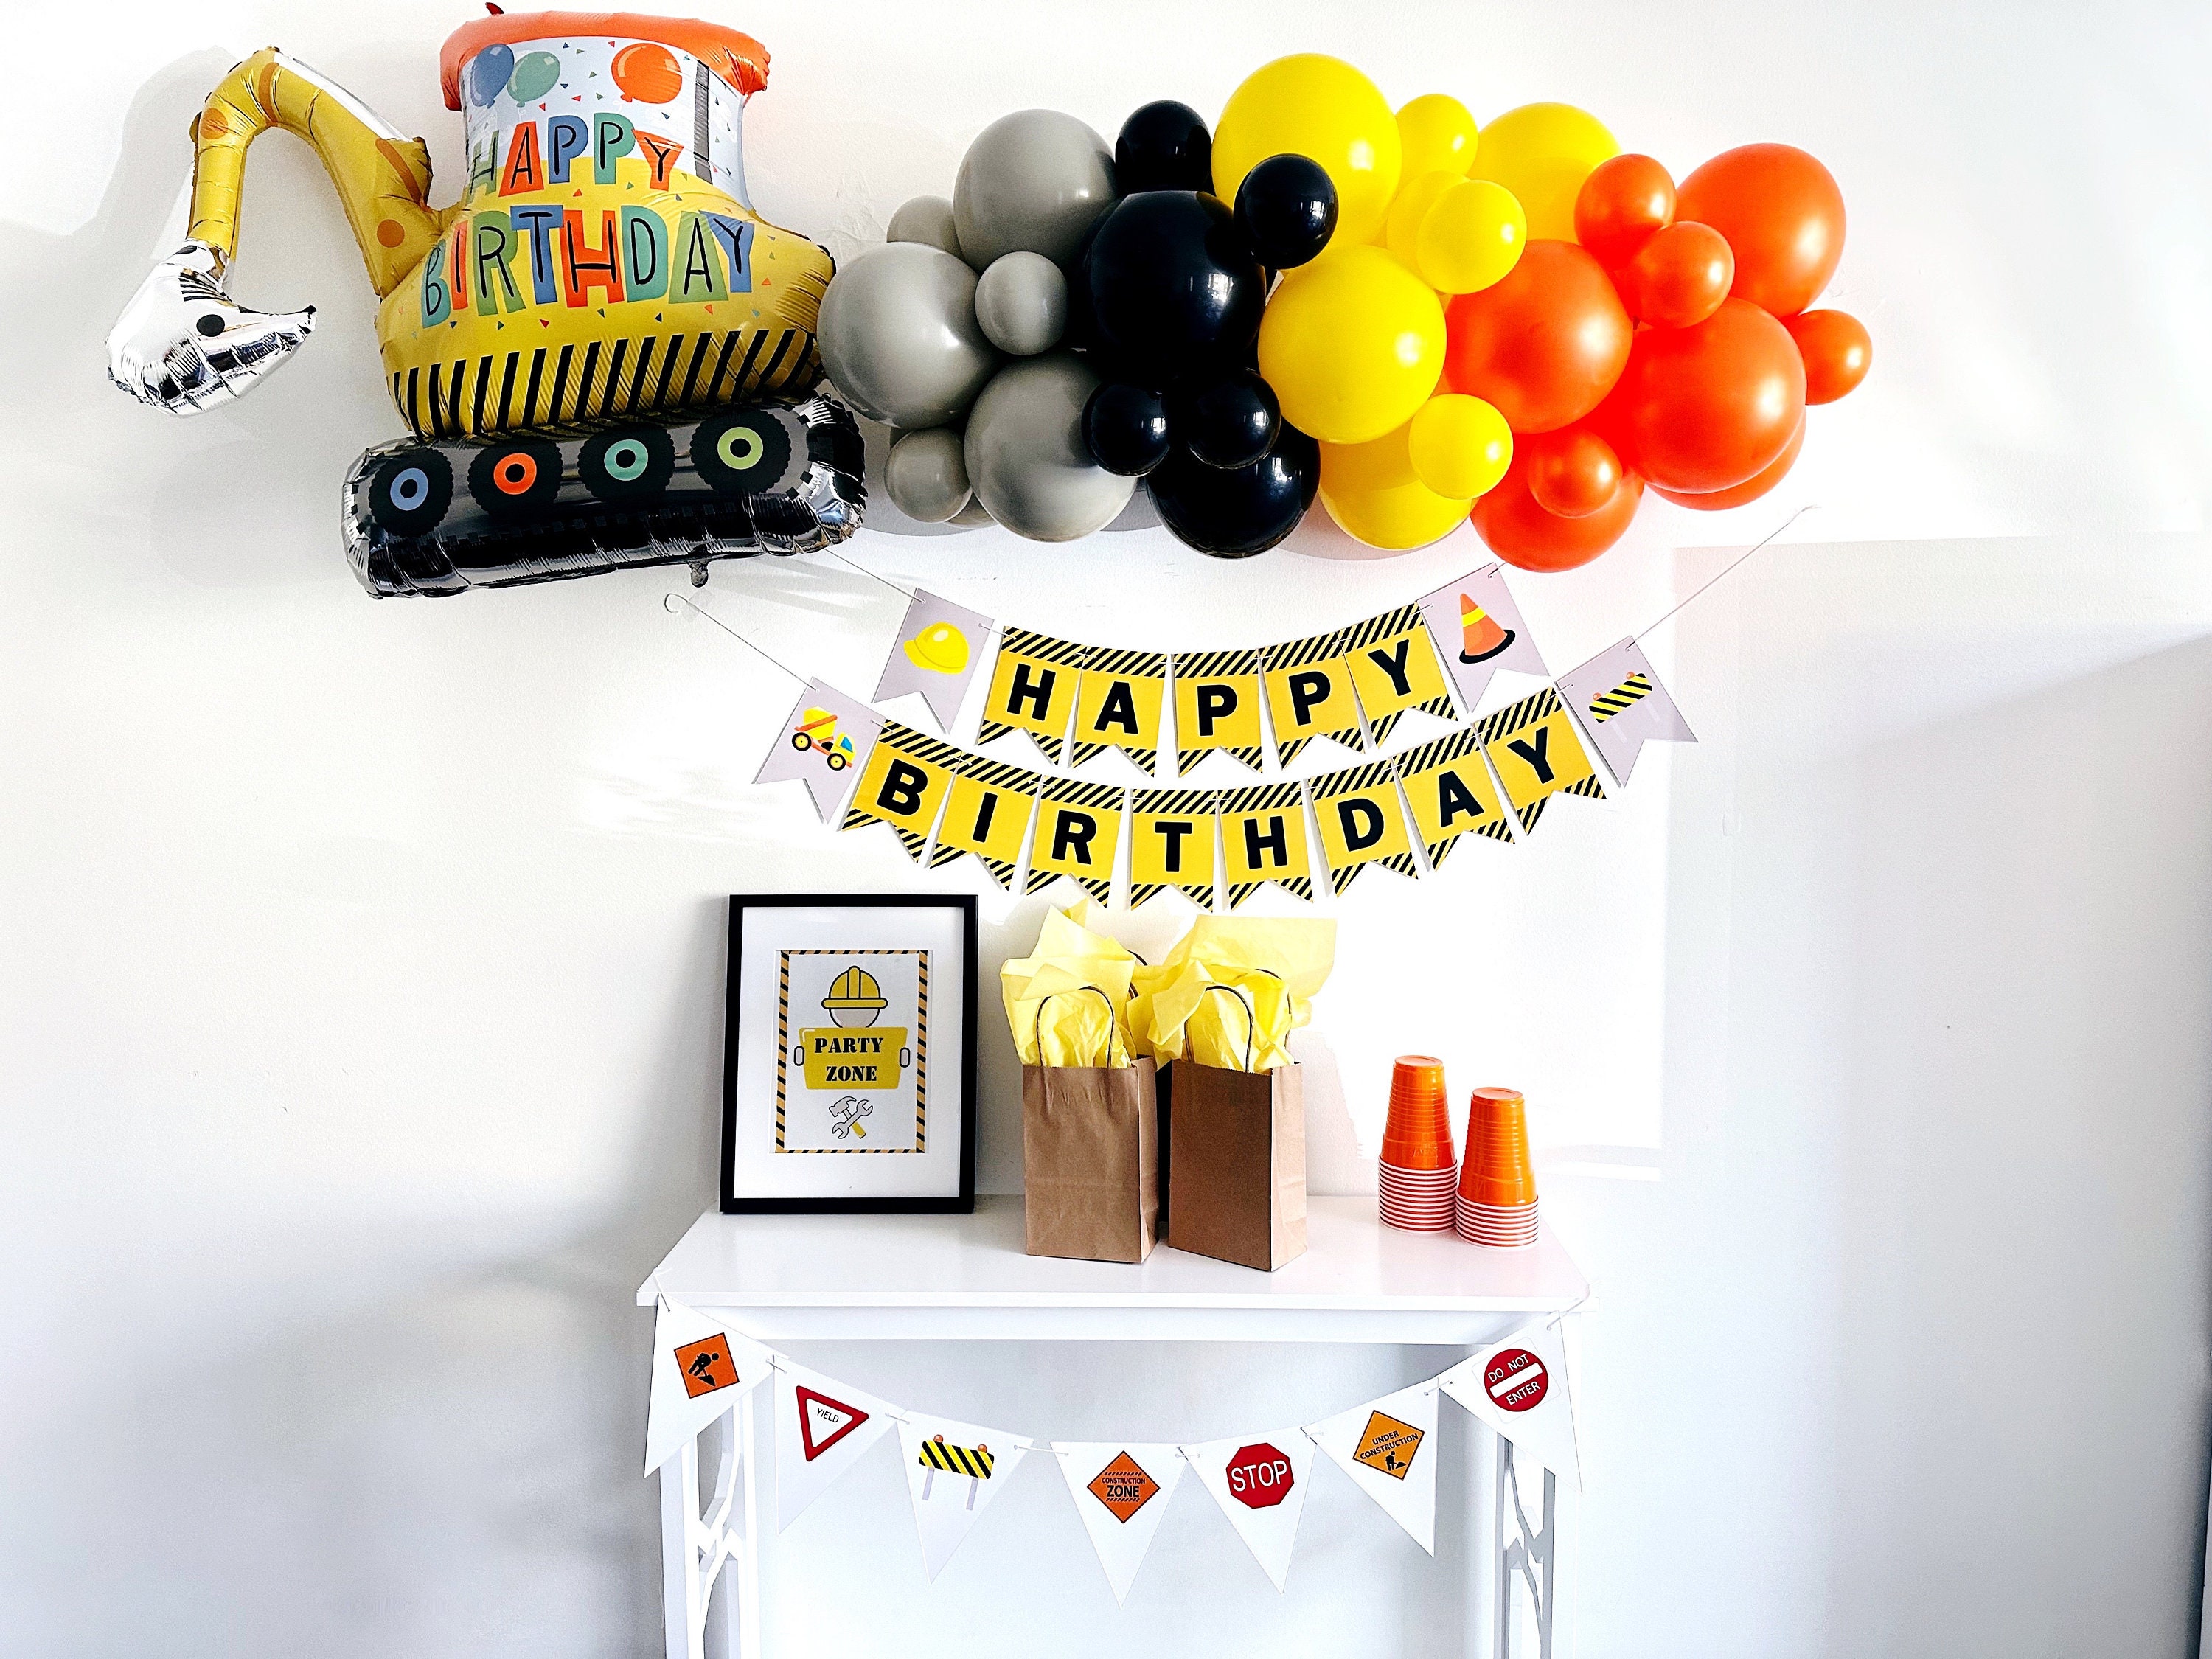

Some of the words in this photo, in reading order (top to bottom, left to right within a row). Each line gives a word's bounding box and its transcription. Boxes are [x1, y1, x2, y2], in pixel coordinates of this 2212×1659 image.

[467, 112, 685, 197] HAPPY
[420, 204, 754, 327] BIRTHDAY
[1006, 639, 1411, 737] HAPPY
[877, 726, 1554, 872] BIRTHDAY
[814, 1037, 884, 1054] PARTY
[825, 1065, 877, 1082] ZONE
[1487, 1368, 1504, 1382] DO
[1507, 1353, 1529, 1371] NOT
[1506, 1381, 1541, 1405] ENTER
[817, 1408, 839, 1423] YIELD
[1360, 1433, 1419, 1459] CONSTRUCTION
[1372, 1430, 1399, 1445] UNDER
[1231, 1460, 1287, 1492] STOP
[1107, 1485, 1139, 1497] ZONE
